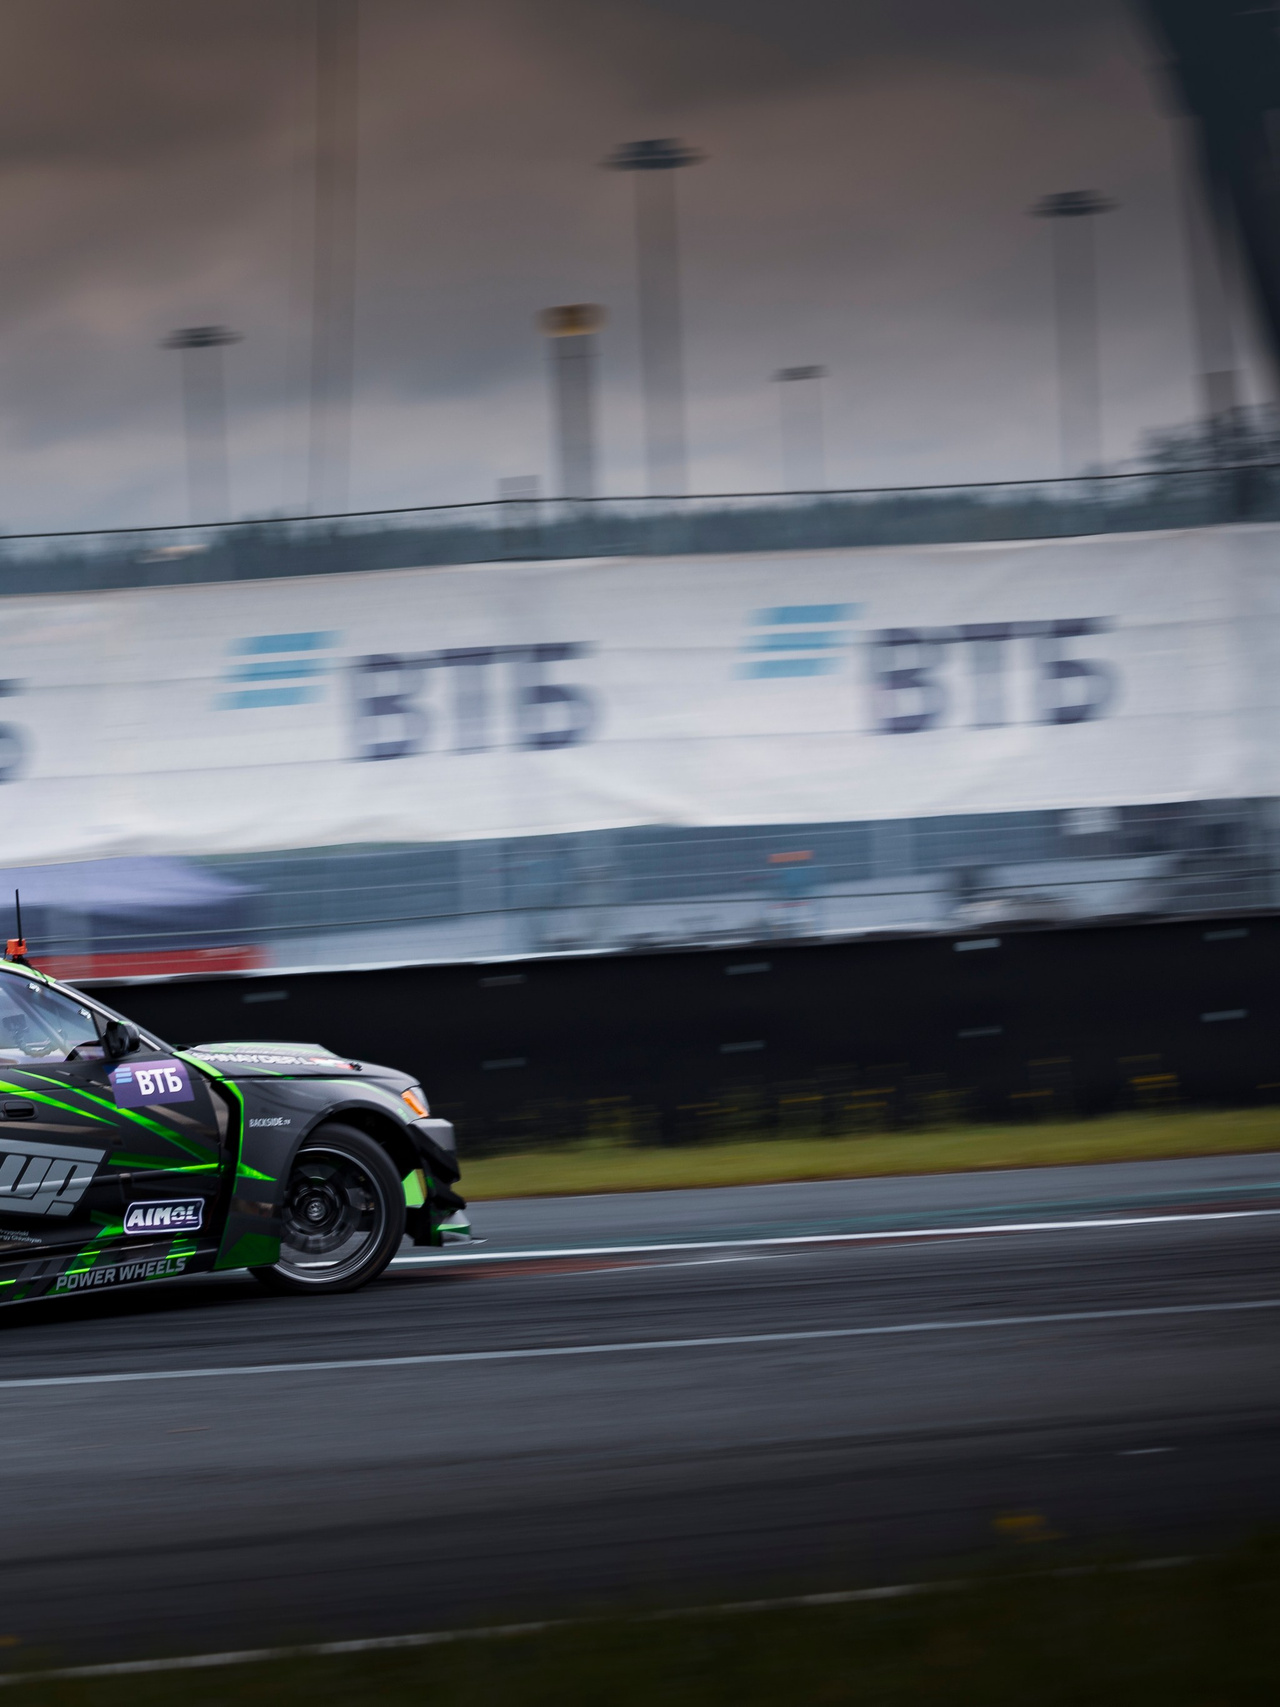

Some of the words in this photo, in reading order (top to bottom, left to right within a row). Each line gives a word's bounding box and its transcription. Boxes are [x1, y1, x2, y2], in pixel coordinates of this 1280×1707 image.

[866, 616, 1124, 735] ВТБ
[350, 640, 604, 762] ВТБ
[134, 1066, 183, 1096] ВТБ
[126, 1204, 199, 1228] AIMOL
[55, 1267, 117, 1291] POWER
[119, 1256, 187, 1282] WHEELS
